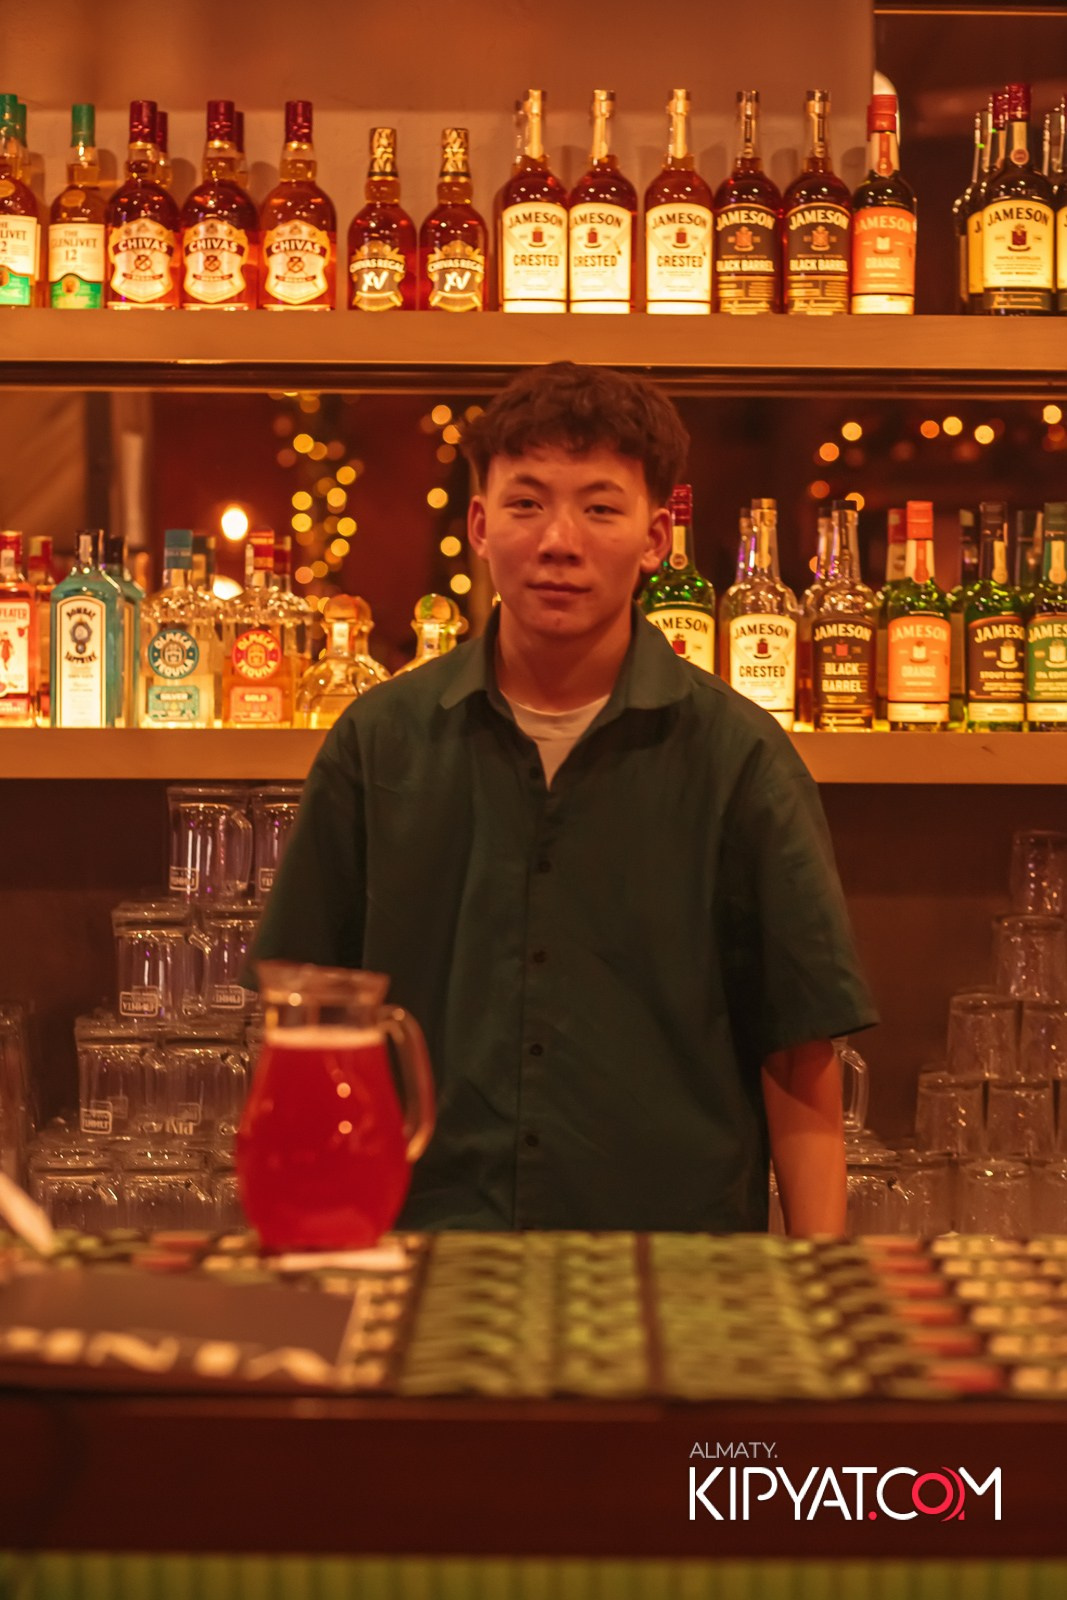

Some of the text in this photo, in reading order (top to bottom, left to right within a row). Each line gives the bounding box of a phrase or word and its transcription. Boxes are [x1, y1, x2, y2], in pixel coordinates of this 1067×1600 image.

[508, 212, 563, 229] JAMESON
[652, 213, 707, 230] JAMESON
[716, 210, 775, 231] JAMESON
[789, 209, 849, 231] JAMESON
[856, 215, 912, 235] JAMESON
[988, 207, 1050, 227] JAMESON
[118, 237, 168, 252] CHIVAS
[189, 237, 238, 253] CHIVAS
[271, 239, 321, 254] CHIVAS
[65, 249, 78, 261] 12
[513, 254, 559, 267] CRESTED
[574, 254, 618, 268] CRESTED
[657, 255, 703, 268] CRESTED
[716, 259, 774, 272] BLACK BARREL
[789, 258, 848, 272] BLACK BARREL
[362, 270, 389, 292] XV
[444, 270, 471, 292] XV
[66, 607, 97, 621] BOMBAY
[655, 616, 709, 634] AMESON
[734, 623, 790, 640] JAMESON
[814, 623, 873, 642] JAMESON
[891, 624, 948, 643] JAMESON
[154, 631, 193, 650] OLMECA
[237, 633, 276, 651] OLMECA
[153, 658, 195, 678] TEQUILA
[237, 659, 278, 679] TEQUILA
[739, 665, 786, 678] CRESTED
[824, 662, 860, 676] BLACK
[821, 679, 863, 693] BARREL
